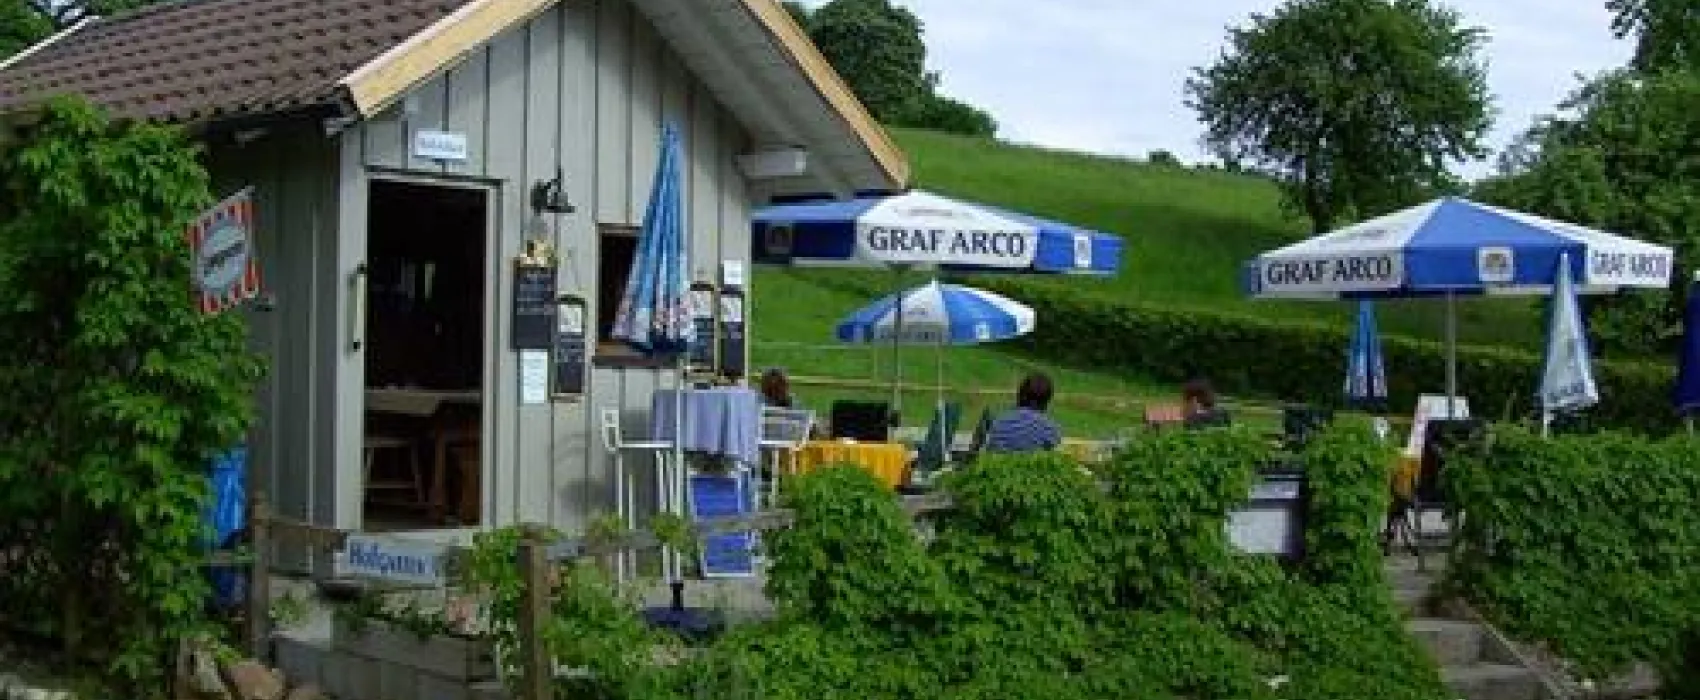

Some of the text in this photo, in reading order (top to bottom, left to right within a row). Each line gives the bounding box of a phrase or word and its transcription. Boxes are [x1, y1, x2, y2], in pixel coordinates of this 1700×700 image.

[867, 225, 1025, 258] GRAF ARCO
[1267, 254, 1392, 285] GRAF ARCO
